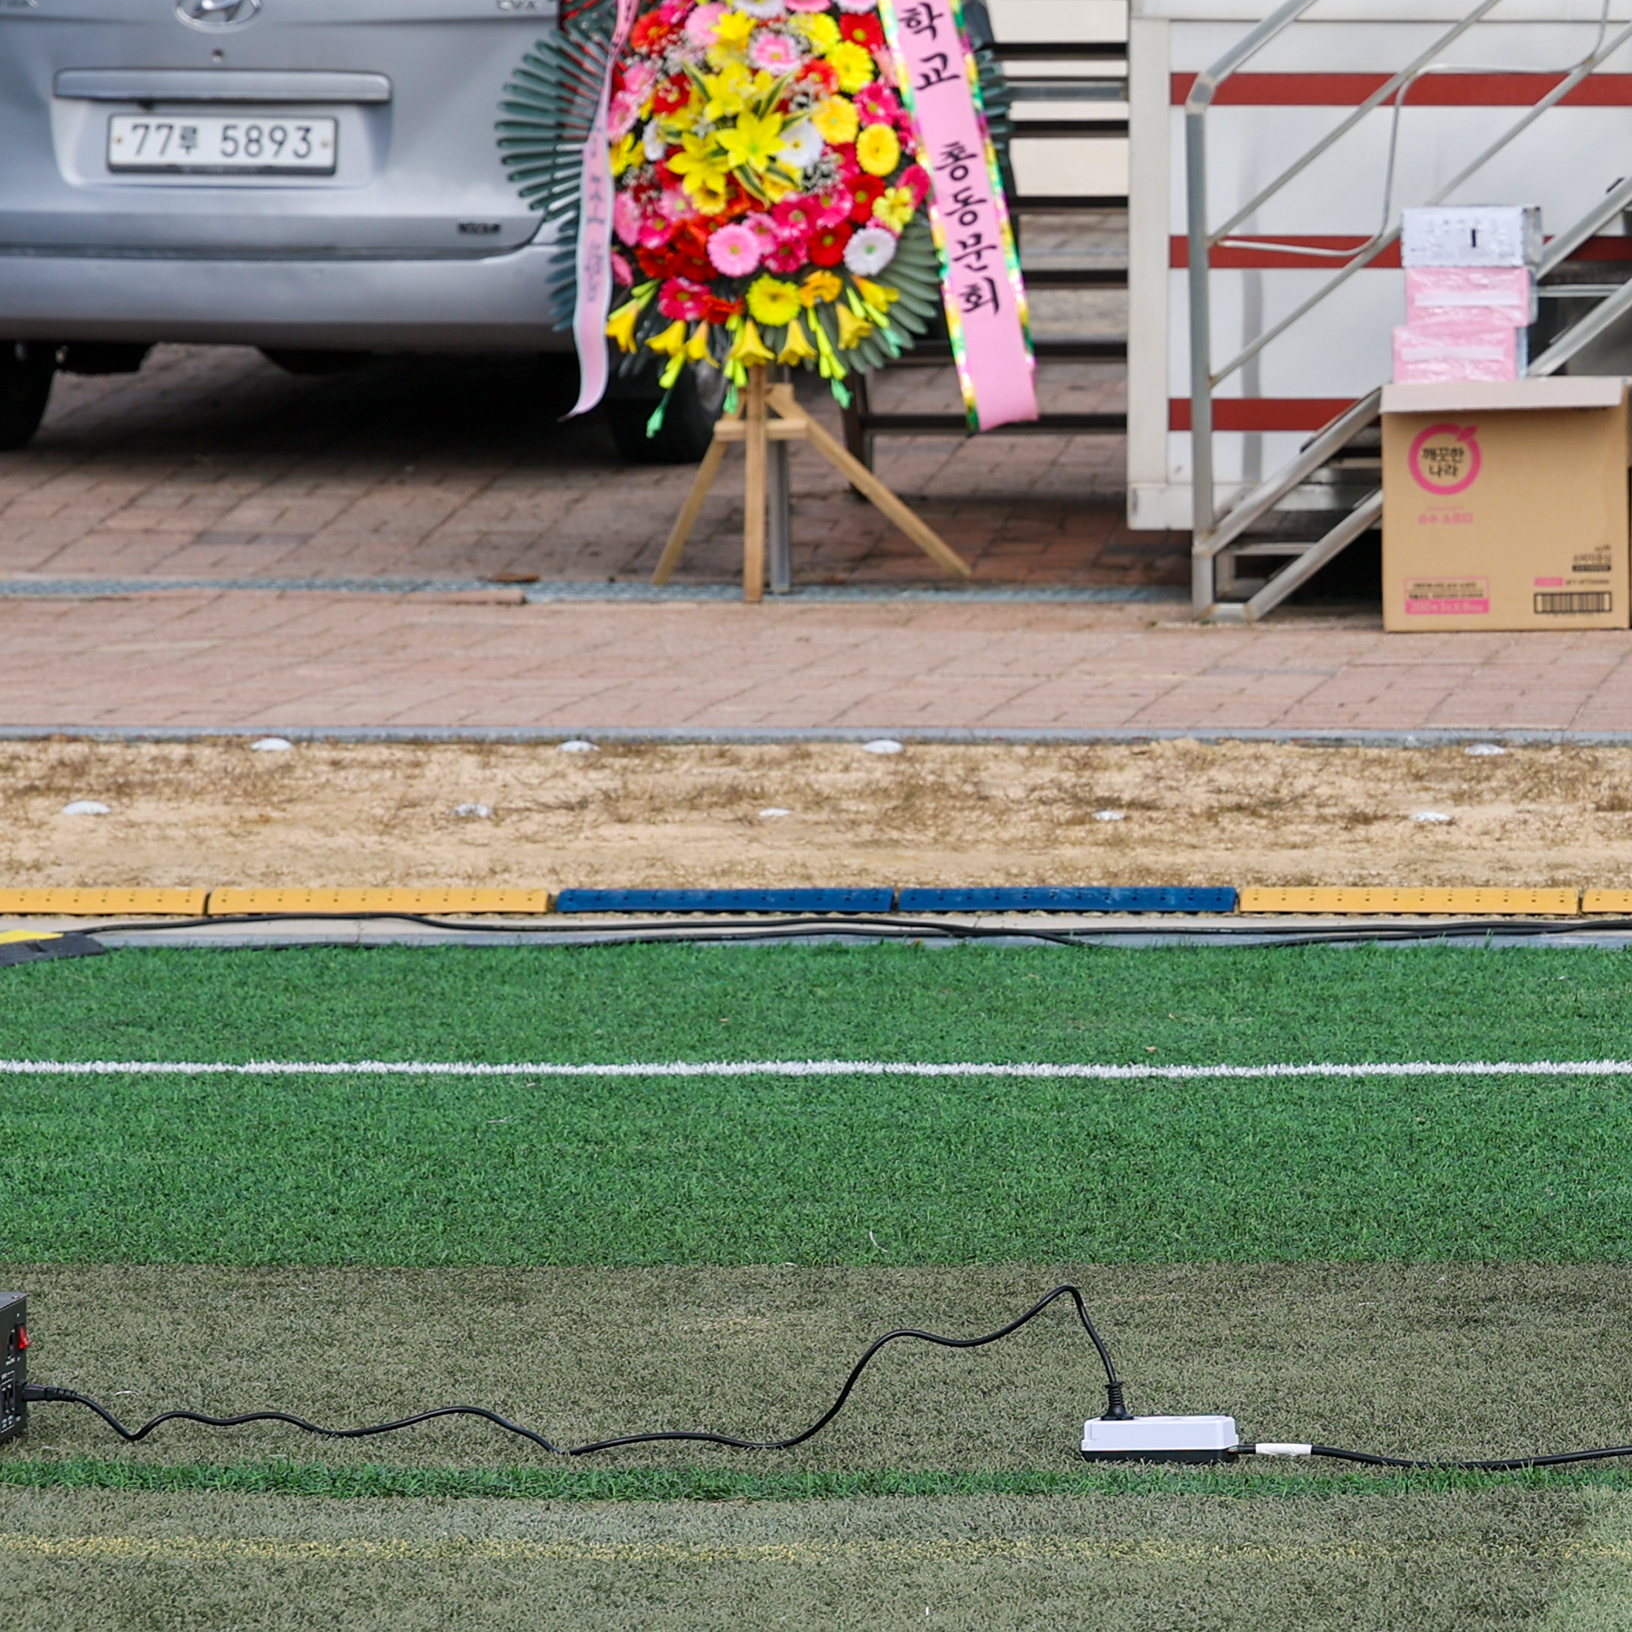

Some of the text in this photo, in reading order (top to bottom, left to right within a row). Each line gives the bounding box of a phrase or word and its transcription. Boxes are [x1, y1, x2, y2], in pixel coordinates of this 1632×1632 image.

[219, 124, 312, 159] 5893
[933, 140, 1001, 316] 총동문회
[1421, 447, 1465, 464] 깨끗한
[1428, 464, 1459, 478] 나라
